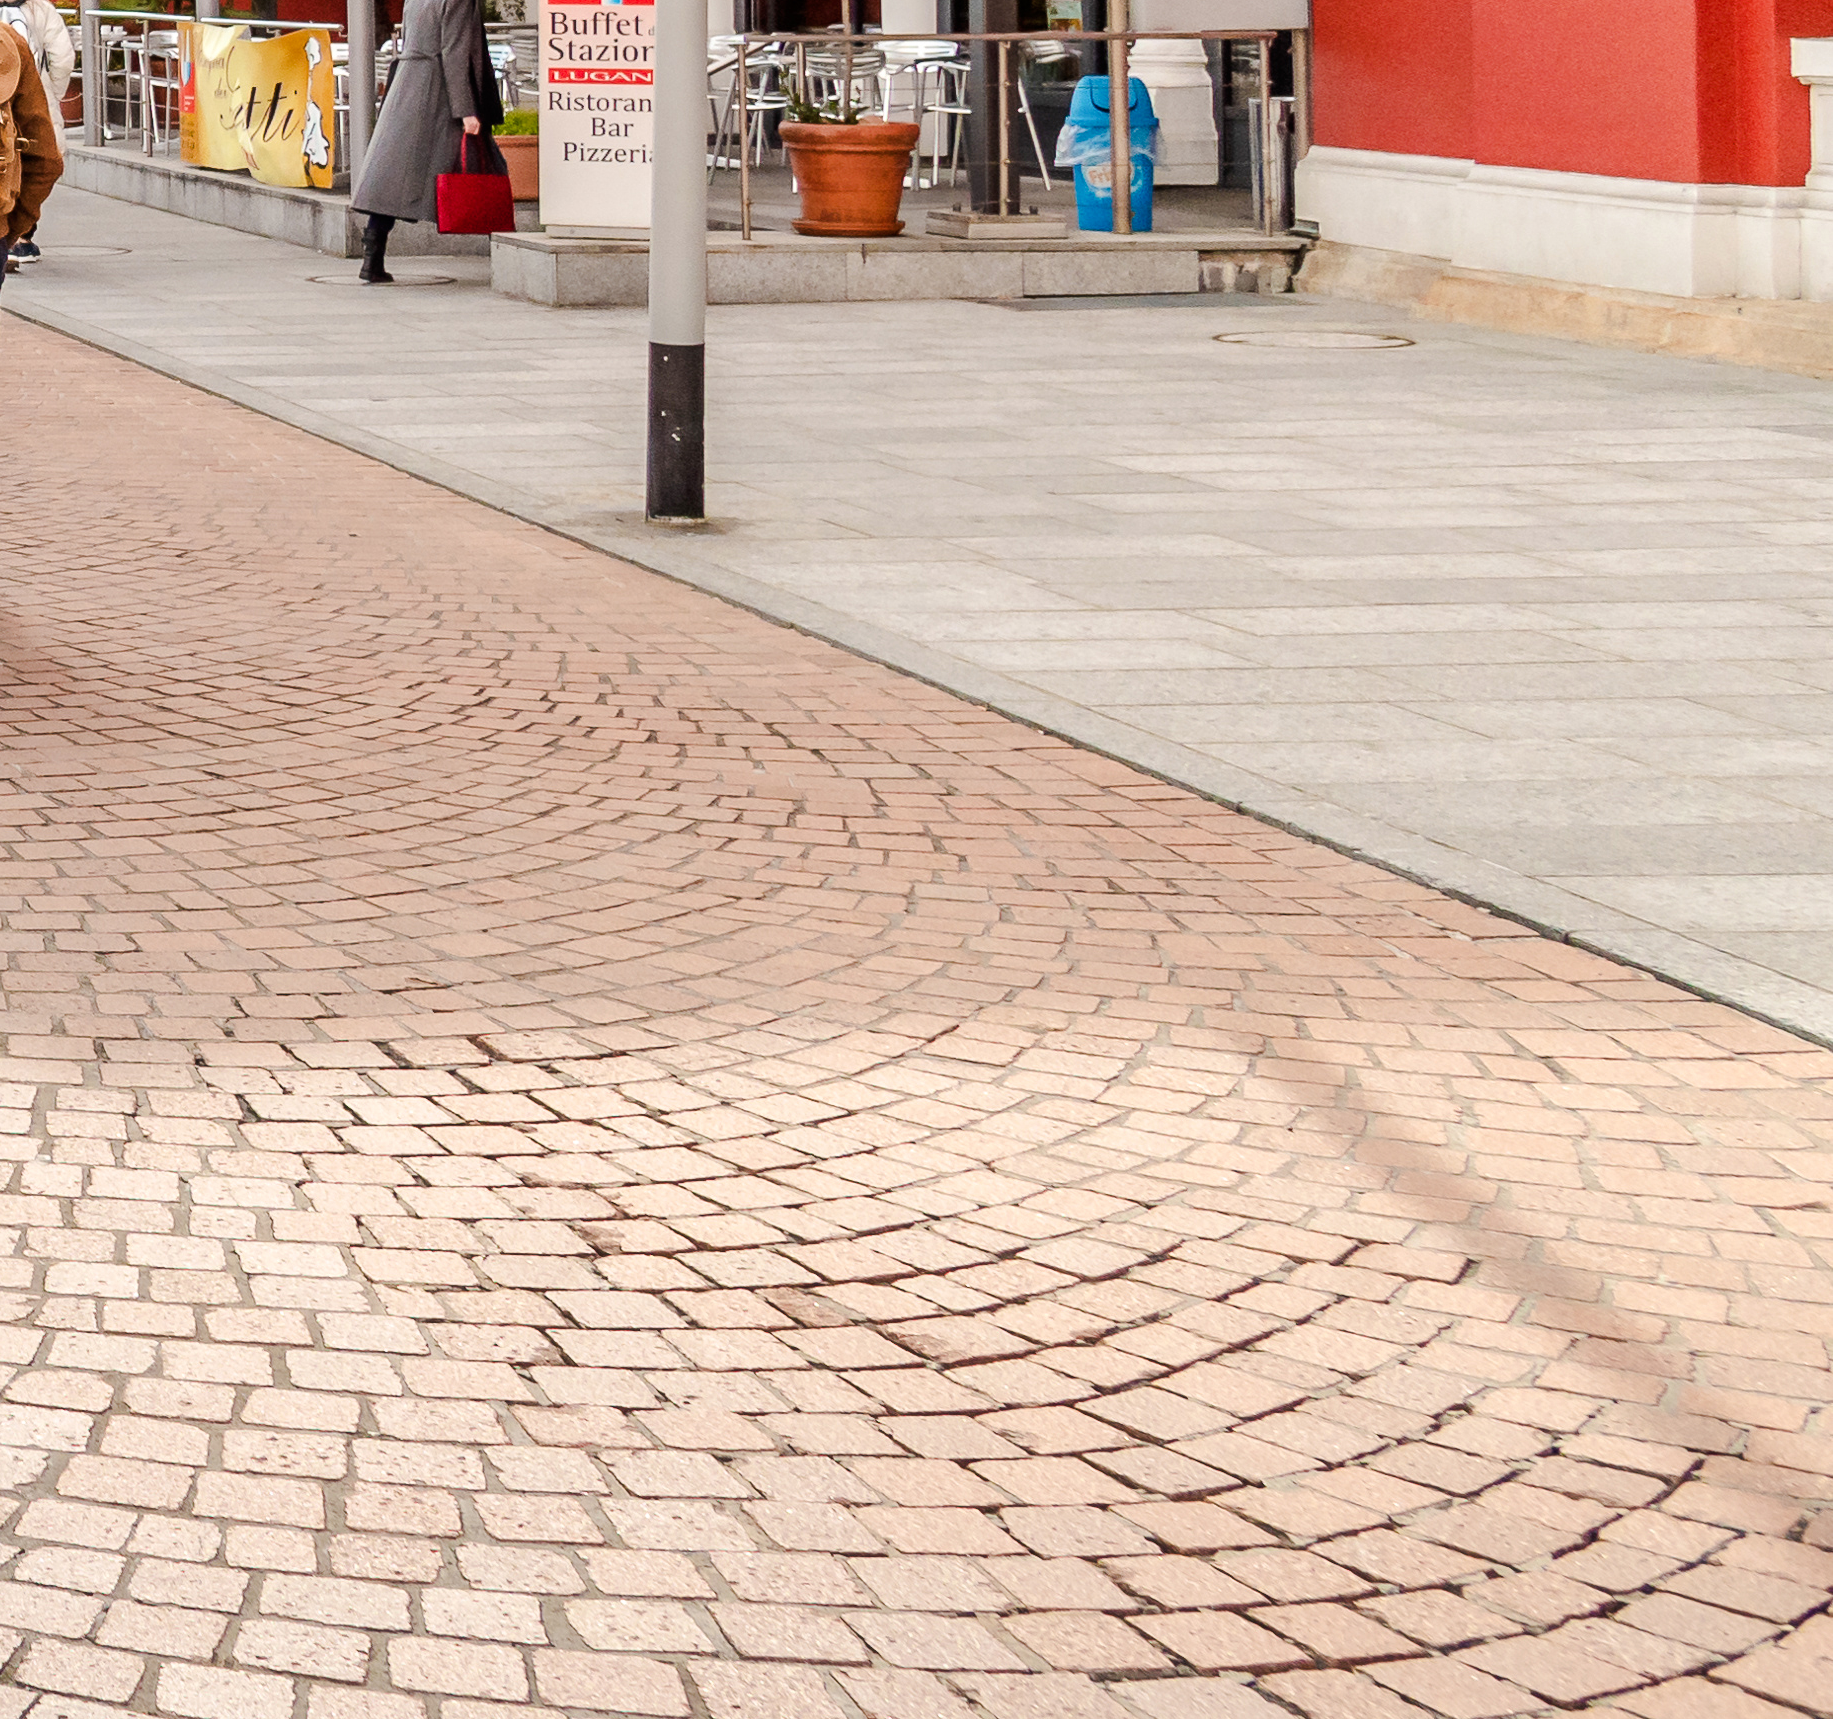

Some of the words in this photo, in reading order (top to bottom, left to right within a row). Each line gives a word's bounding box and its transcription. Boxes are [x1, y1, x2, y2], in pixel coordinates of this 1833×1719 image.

[548, 11, 644, 37] Buffet
[553, 71, 652, 82] LUGAN
[548, 91, 653, 113] Ristoran
[591, 117, 634, 137] Bar
